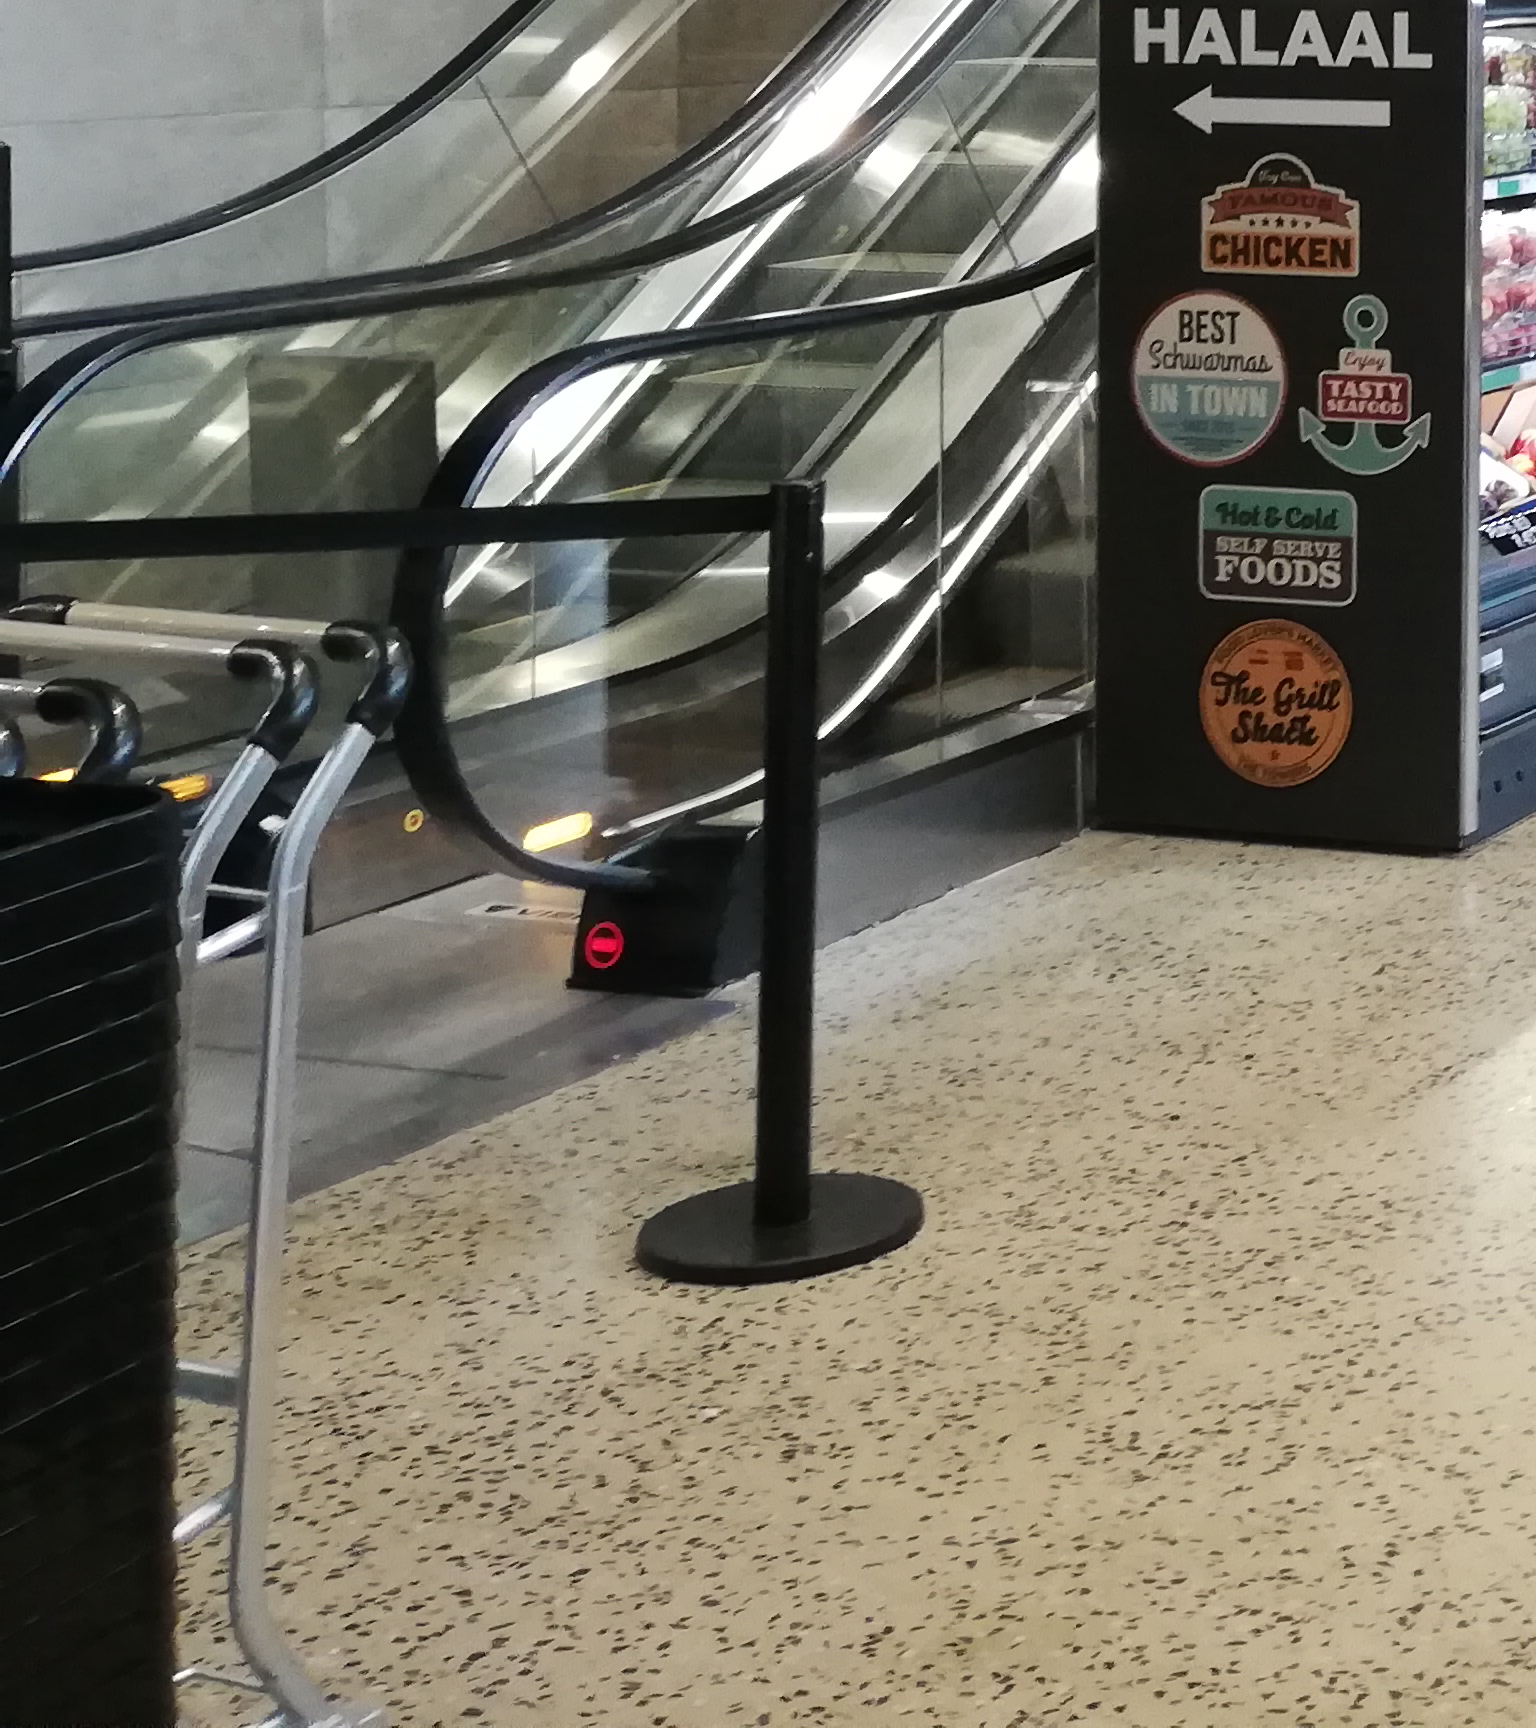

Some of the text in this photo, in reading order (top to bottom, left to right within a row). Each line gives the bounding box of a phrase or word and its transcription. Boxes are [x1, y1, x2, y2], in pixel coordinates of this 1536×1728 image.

[1133, 7, 1434, 69] HALAAL
[1228, 191, 1333, 210] FAMOUS
[1209, 233, 1352, 268] CHICKEN
[1178, 309, 1241, 345] BEST
[1149, 338, 1273, 373] Schwarmas
[1344, 352, 1386, 371] Enjoy
[1149, 383, 1268, 418] IN TOWN
[1326, 379, 1402, 400] TASTY
[1326, 398, 1403, 415] SEAFOOD
[1215, 501, 1339, 530] Hot & Cold
[1216, 535, 1342, 559] SELF SERVE
[1214, 555, 1342, 589] FOODS
[1211, 670, 1342, 717] The Grill
[1231, 710, 1320, 747] Shack
